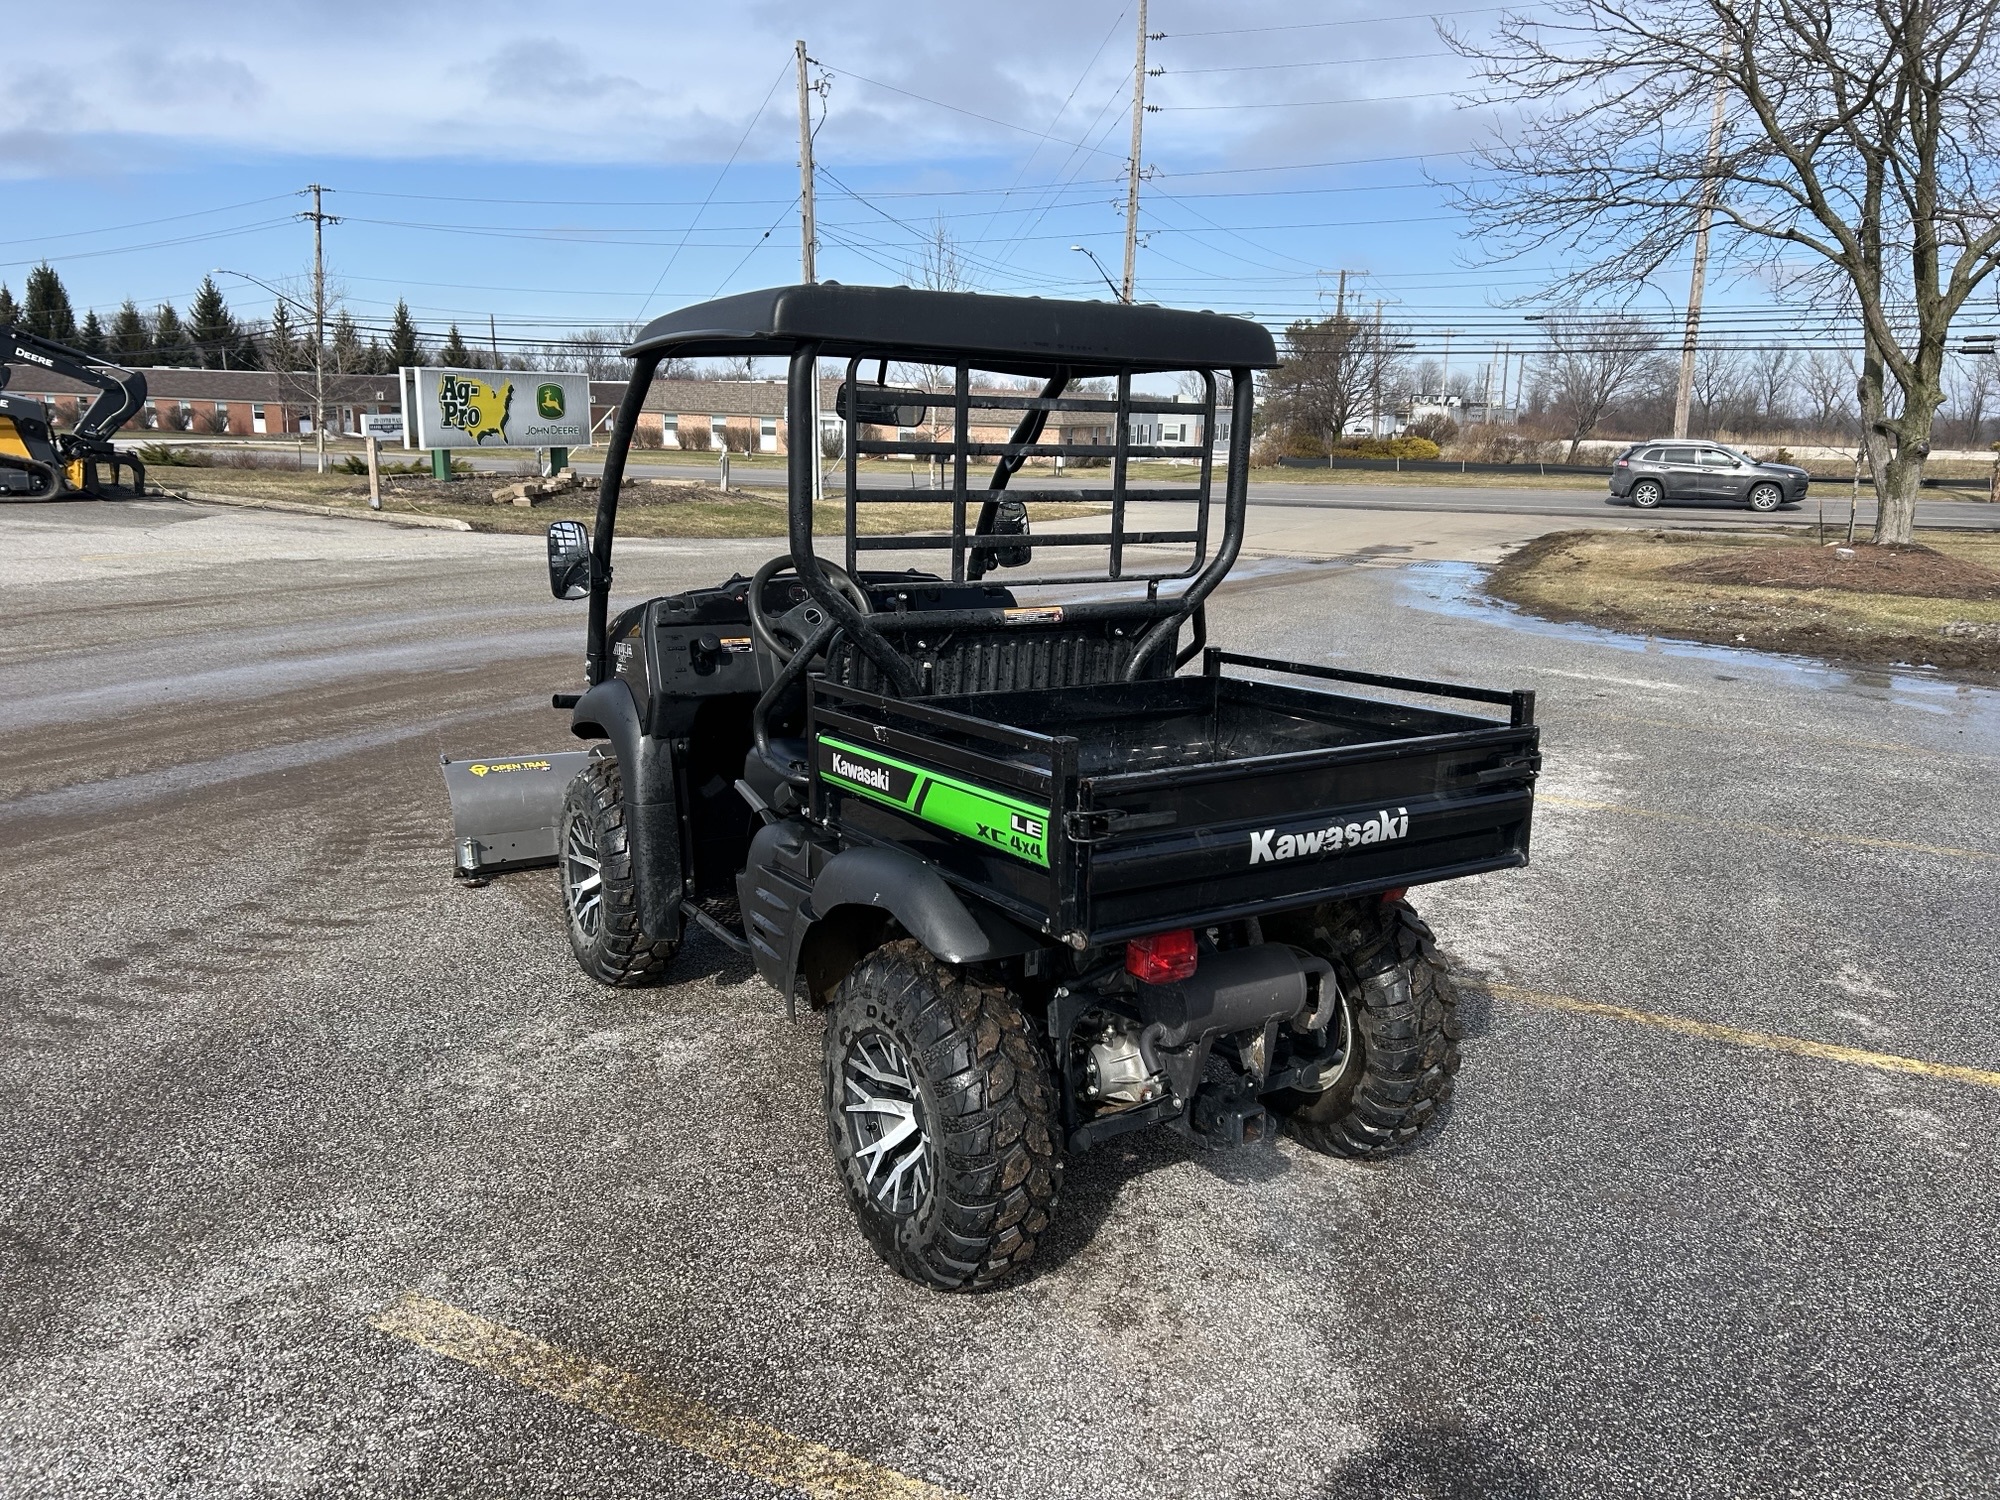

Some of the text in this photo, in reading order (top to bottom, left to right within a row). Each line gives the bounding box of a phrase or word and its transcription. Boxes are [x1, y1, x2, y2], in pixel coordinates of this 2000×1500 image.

[15, 347, 54, 367] DEERE
[440, 373, 480, 408] Ag-
[441, 401, 481, 428] Pro
[525, 424, 579, 435] JOHN DEERE
[490, 763, 521, 772] OPEN
[520, 760, 551, 769] TRAIL
[832, 752, 890, 792] Kawasaki
[1011, 814, 1043, 838] LE
[1249, 807, 1409, 865] Kawasaki
[975, 822, 1043, 860] XC 4x4
